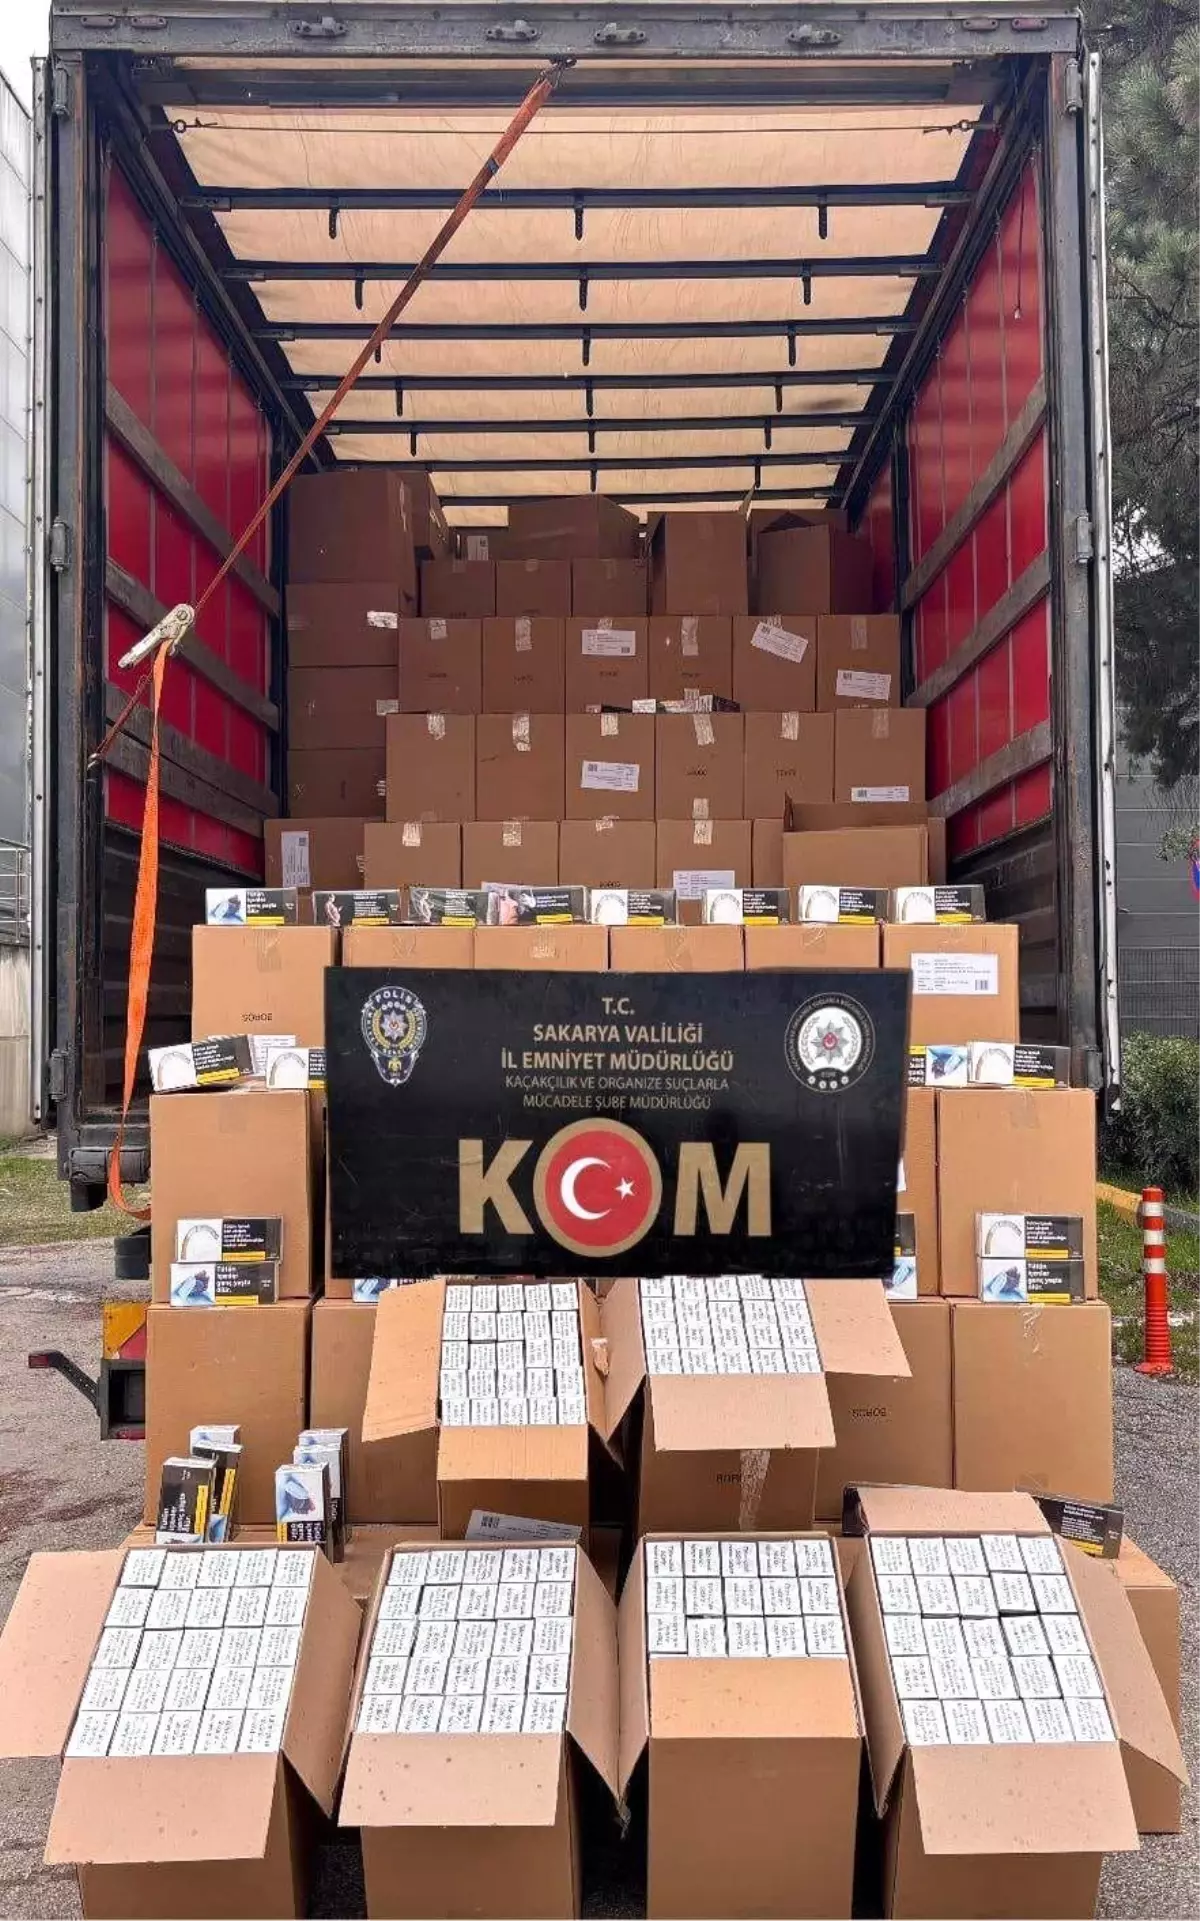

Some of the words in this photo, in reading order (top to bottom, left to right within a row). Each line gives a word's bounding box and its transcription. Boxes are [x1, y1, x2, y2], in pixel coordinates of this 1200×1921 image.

[601, 996, 636, 1015] T.C.
[533, 1023, 621, 1043] SAKARYA
[624, 1021, 703, 1043] VALİLİĞİ
[501, 1047, 518, 1069] İL
[522, 1049, 606, 1070] EMNİYET
[609, 1050, 734, 1071] MÜDÜRLÜĞÜ
[505, 1075, 578, 1092] KAÇAKÇILIK
[580, 1076, 596, 1089] VE
[665, 1077, 730, 1092] SUÇLARLA
[523, 1093, 593, 1109] MÜCADELE
[595, 1095, 627, 1111] ŞUBE
[629, 1094, 711, 1110] MÜDÜRLÜĞÜ
